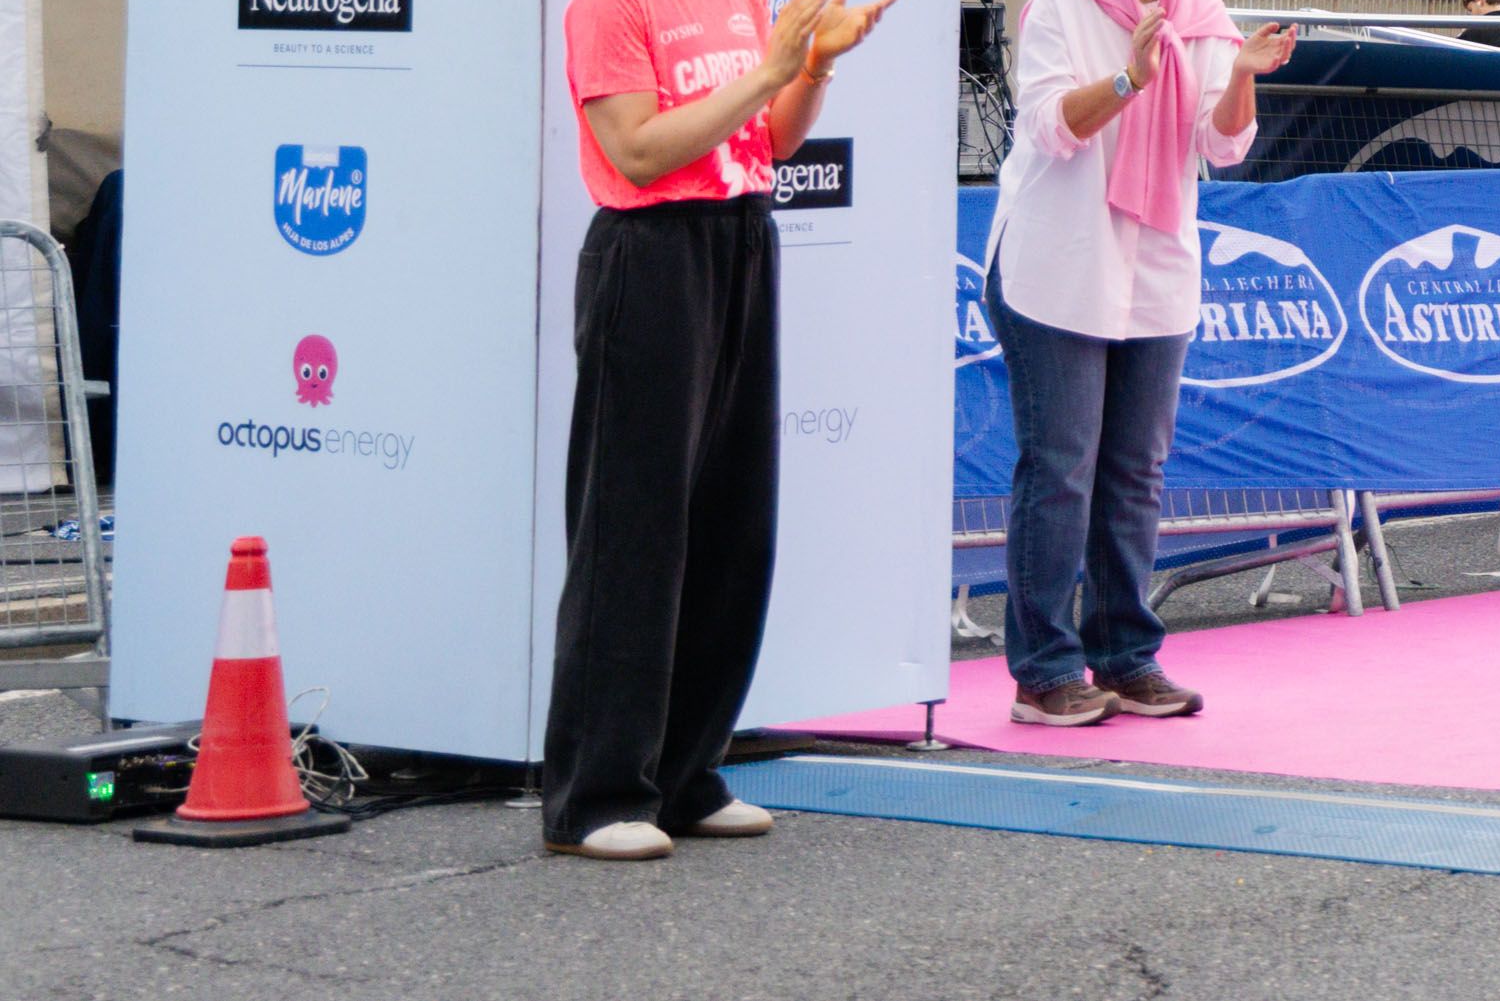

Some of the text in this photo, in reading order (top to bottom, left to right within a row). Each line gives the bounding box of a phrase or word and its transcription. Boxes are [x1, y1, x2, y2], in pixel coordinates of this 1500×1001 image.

[660, 22, 704, 45] OYSHO
[273, 43, 374, 55] BEAUTY TO A SCIENCE
[279, 167, 362, 226] Marlene
[779, 222, 815, 234] CIENCE
[312, 240, 330, 251] LOS
[1224, 272, 1315, 292] LECHERA
[783, 406, 859, 444] nergy
